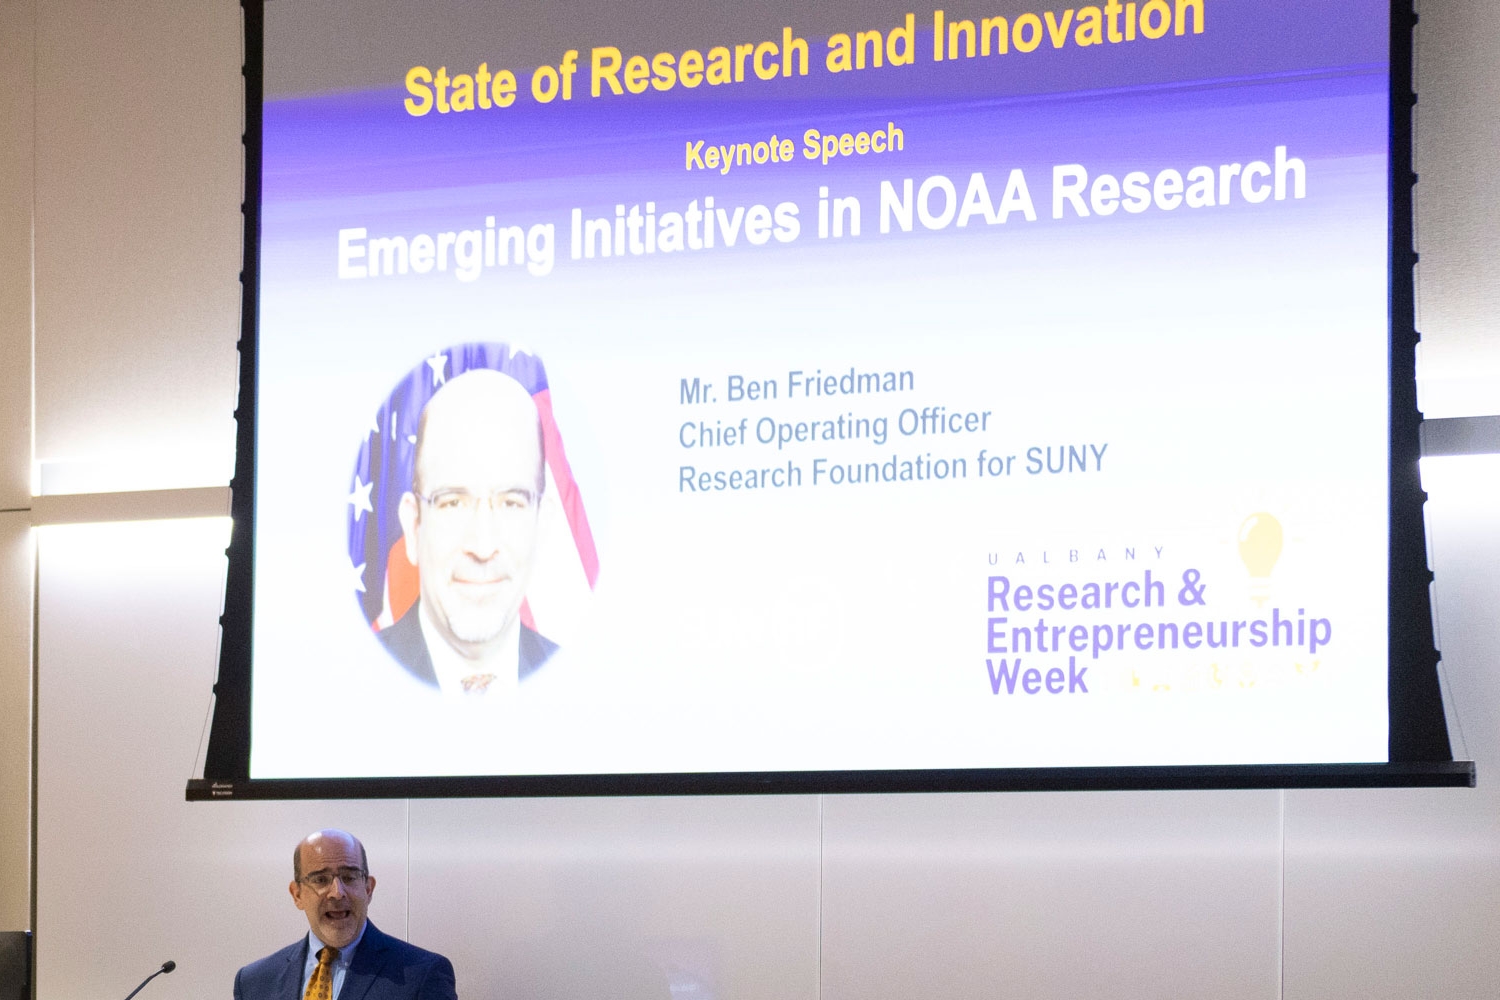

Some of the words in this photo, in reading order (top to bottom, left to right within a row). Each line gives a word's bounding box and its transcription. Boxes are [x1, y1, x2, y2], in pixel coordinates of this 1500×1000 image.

[403, 64, 517, 116] State
[532, 50, 578, 103] of
[591, 27, 808, 98] Research
[826, 14, 915, 72] and
[934, 0, 1205, 60] Innovation
[685, 135, 794, 174] Keynote
[802, 121, 904, 164] Speech
[338, 216, 554, 282] Emerging
[572, 196, 800, 260] Initiatives
[818, 185, 860, 238] in
[880, 168, 1036, 233] NOAA
[1052, 145, 1306, 219] Research
[679, 378, 717, 404] Mr.
[727, 375, 777, 402] Ben
[788, 367, 914, 399] Friedman
[679, 418, 748, 448] Chief
[756, 412, 888, 449] Operating
[899, 407, 991, 436] Officer
[679, 460, 801, 492] Research
[813, 455, 966, 485] Foundation
[978, 450, 1016, 476] for
[1025, 443, 1108, 475] SUNY
[987, 569, 1165, 612] Research
[1178, 568, 1206, 606] &
[987, 608, 1331, 658] Entrepreneurship
[986, 657, 1088, 695] Week
